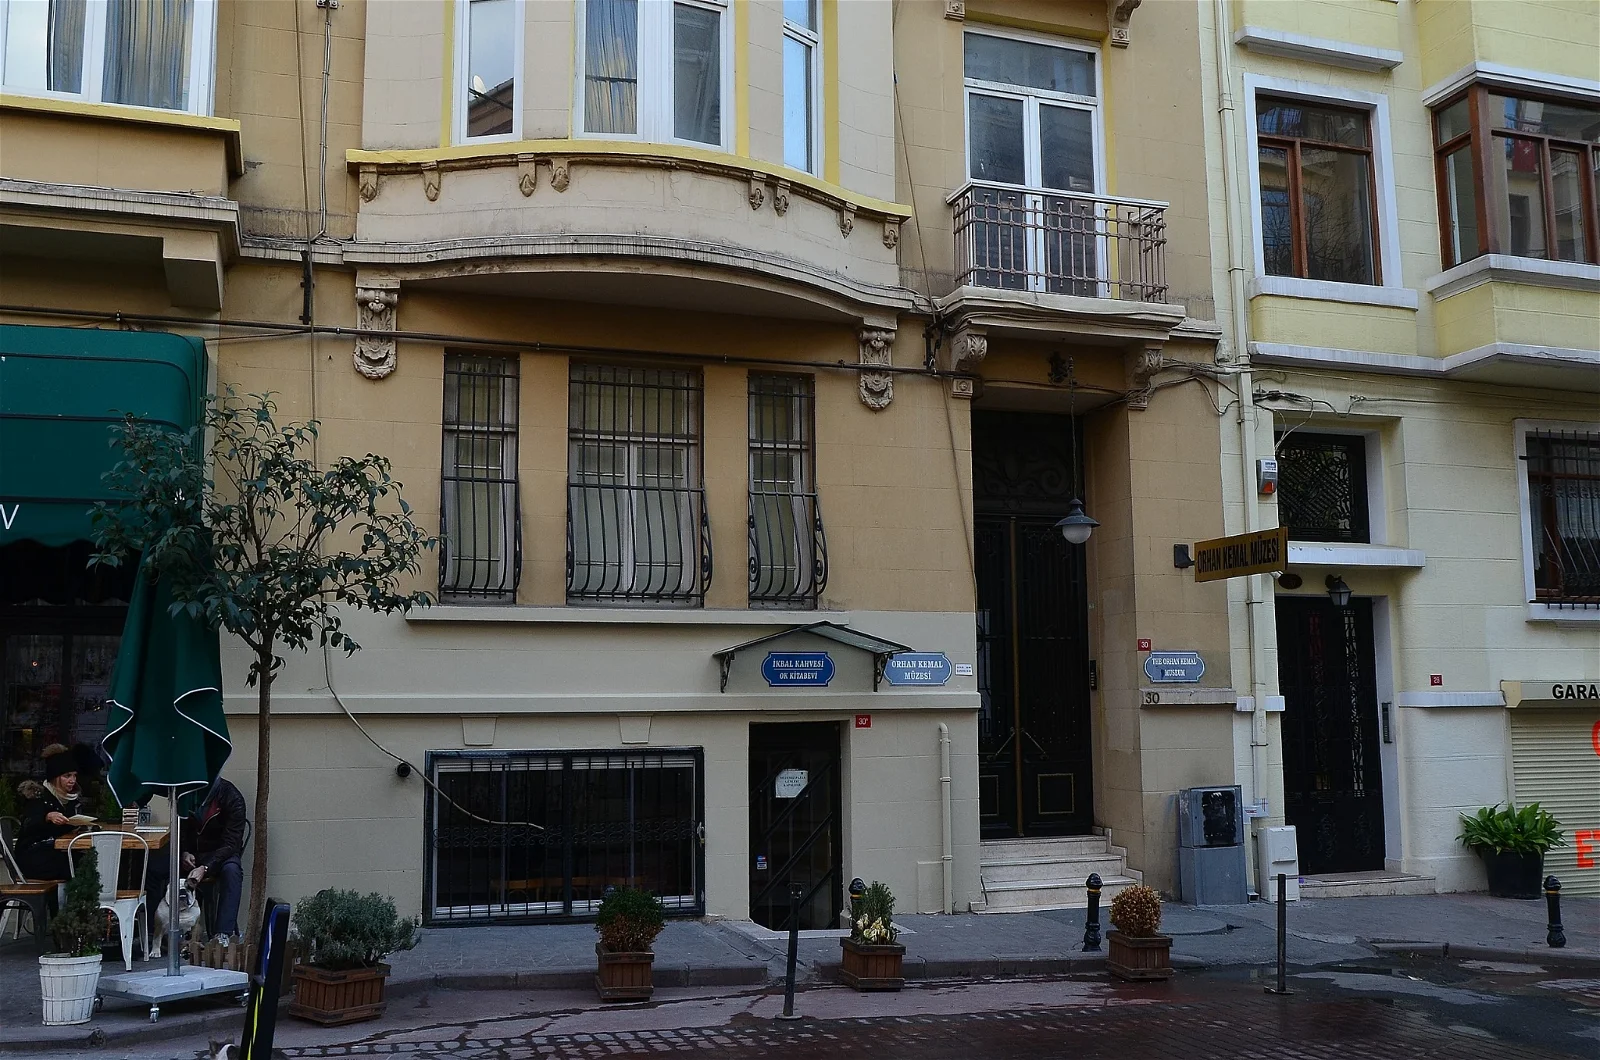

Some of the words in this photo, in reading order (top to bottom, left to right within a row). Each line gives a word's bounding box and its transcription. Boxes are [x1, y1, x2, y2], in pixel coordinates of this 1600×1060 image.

[1197, 547, 1221, 574] ORHAN
[1223, 543, 1249, 570] KEMAL
[1250, 531, 1280, 566] MÜZESİ
[1141, 641, 1149, 649] 30
[772, 658, 794, 668] İKBAL
[795, 658, 824, 668] KAHVESİ
[891, 660, 917, 668] ORHAN
[918, 660, 944, 668] KEMAL
[1152, 657, 1162, 665] THE
[1162, 657, 1180, 665] ORHAN
[1180, 657, 1198, 665] KEMAL
[779, 672, 789, 680] OK
[789, 671, 818, 680] KİTABEVİ
[904, 670, 932, 680] MÜZESİ
[1164, 669, 1186, 677] MUSEUM
[1552, 684, 1600, 699] GARA
[1145, 692, 1160, 704] 30
